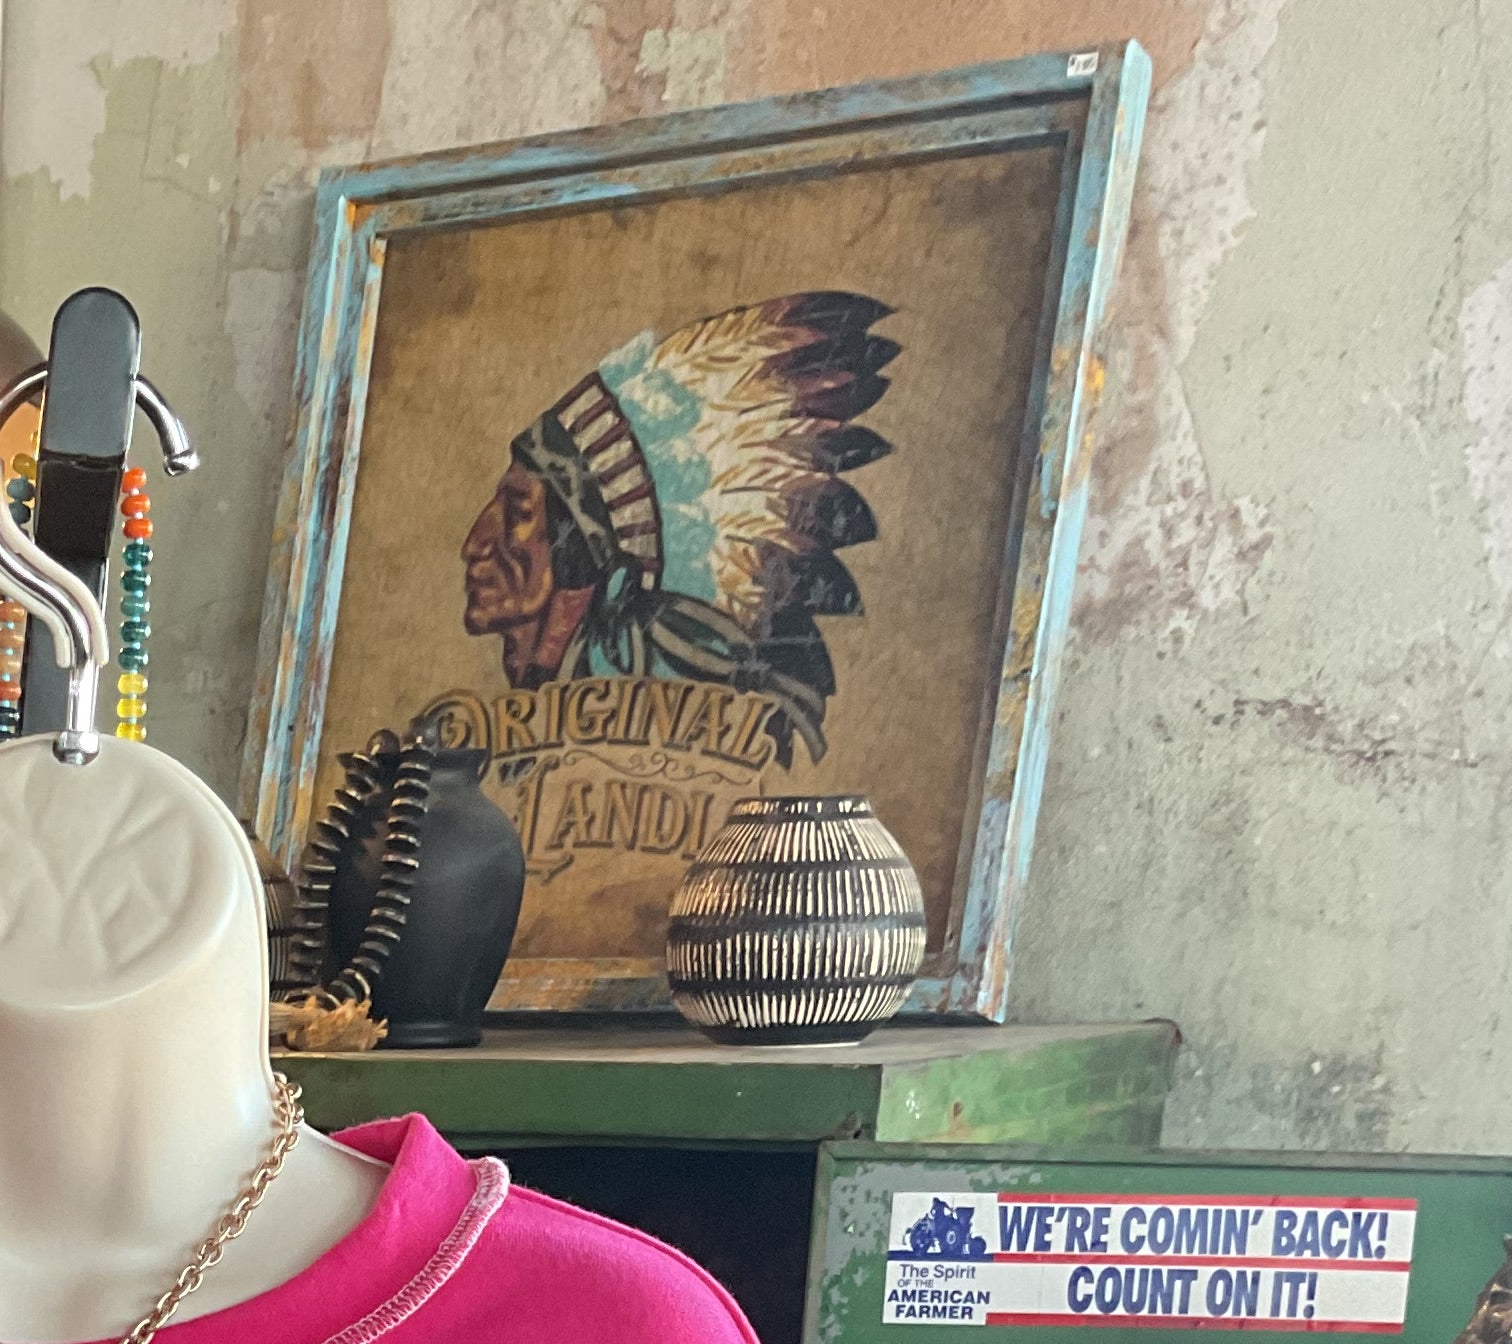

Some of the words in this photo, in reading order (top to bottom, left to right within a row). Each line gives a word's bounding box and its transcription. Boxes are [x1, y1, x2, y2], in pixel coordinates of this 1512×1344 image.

[414, 680, 775, 771] ORIGINAL
[998, 1205, 1111, 1254] WE'RE
[1120, 1206, 1264, 1256] COMIN'
[1271, 1209, 1389, 1260] BACK!
[900, 1264, 929, 1279] The
[933, 1264, 976, 1282] Spirit
[897, 1279, 911, 1288] OF
[915, 1279, 934, 1288] THE
[1067, 1265, 1198, 1315] COUNT
[1206, 1268, 1261, 1317] ON
[1269, 1270, 1317, 1320] IT!
[887, 1289, 990, 1305] AMERICAN
[895, 1304, 973, 1320] FARMER
